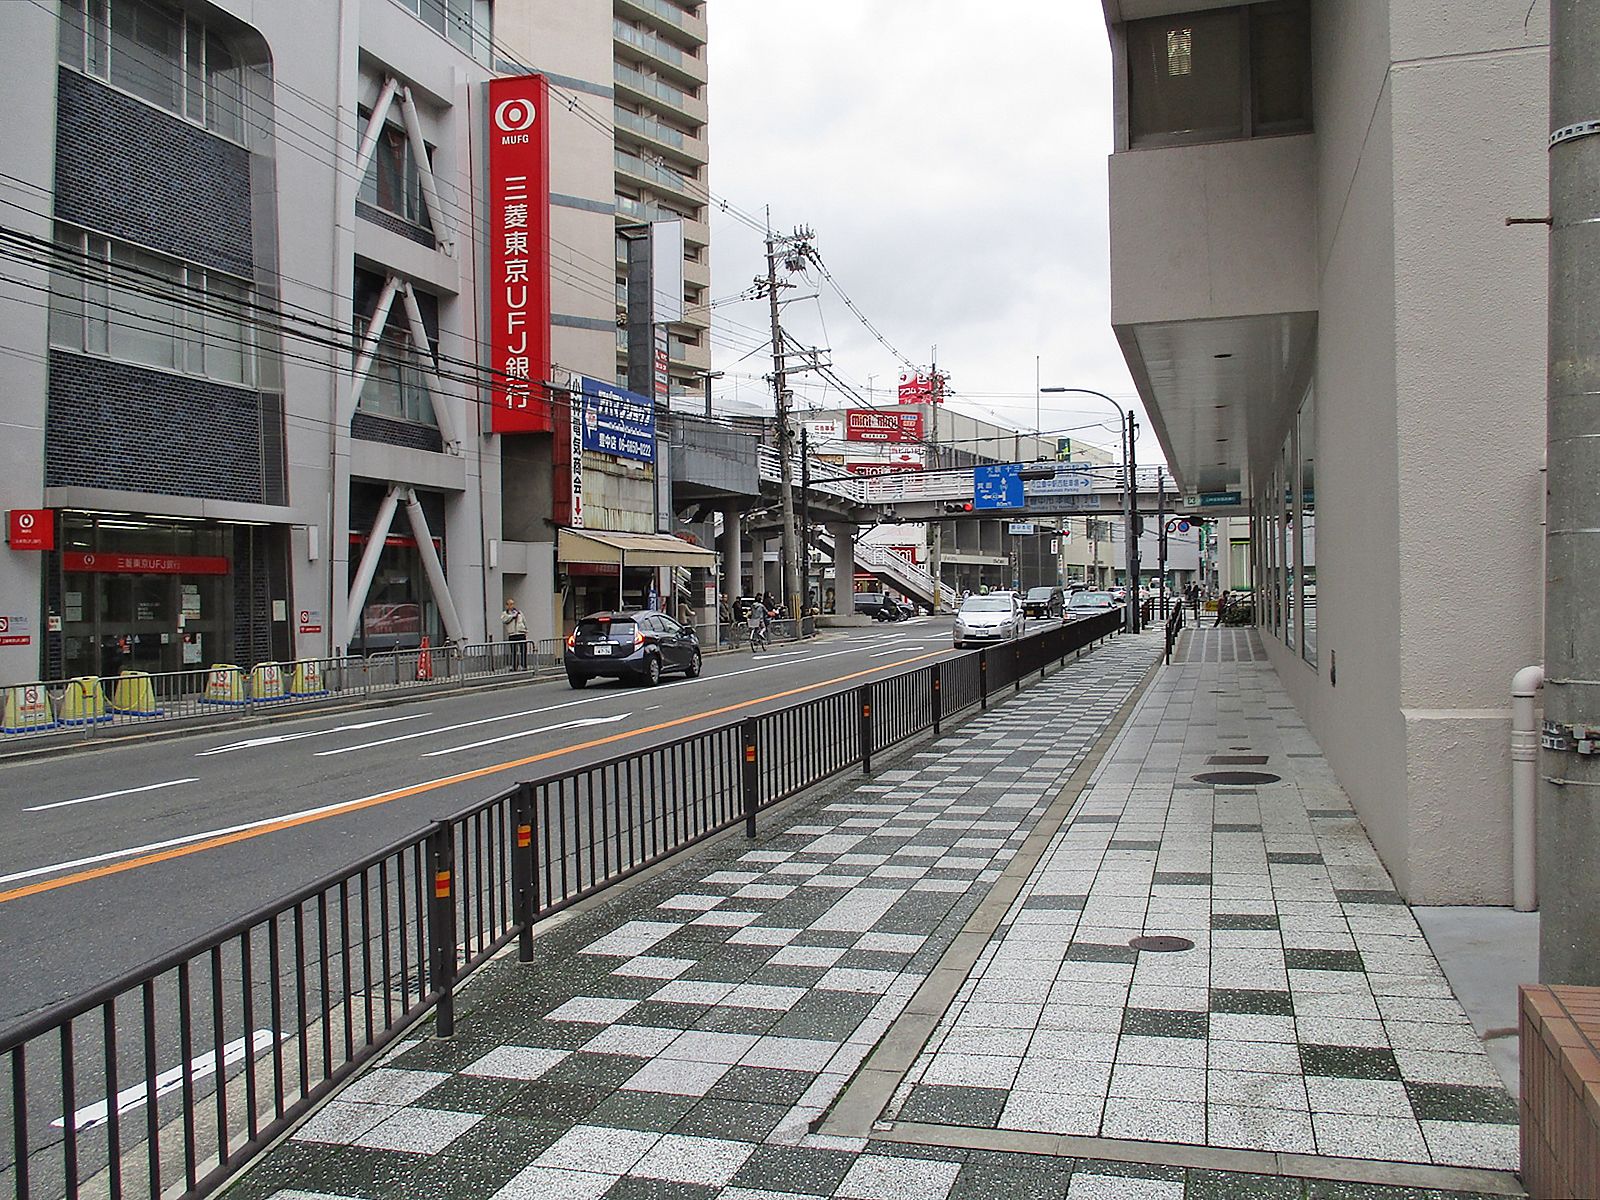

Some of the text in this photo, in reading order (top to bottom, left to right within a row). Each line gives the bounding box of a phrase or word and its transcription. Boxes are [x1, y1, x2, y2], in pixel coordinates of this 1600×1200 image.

[502, 135, 529, 145] MUFG
[504, 176, 529, 409] 三菱東京UFJ銀行
